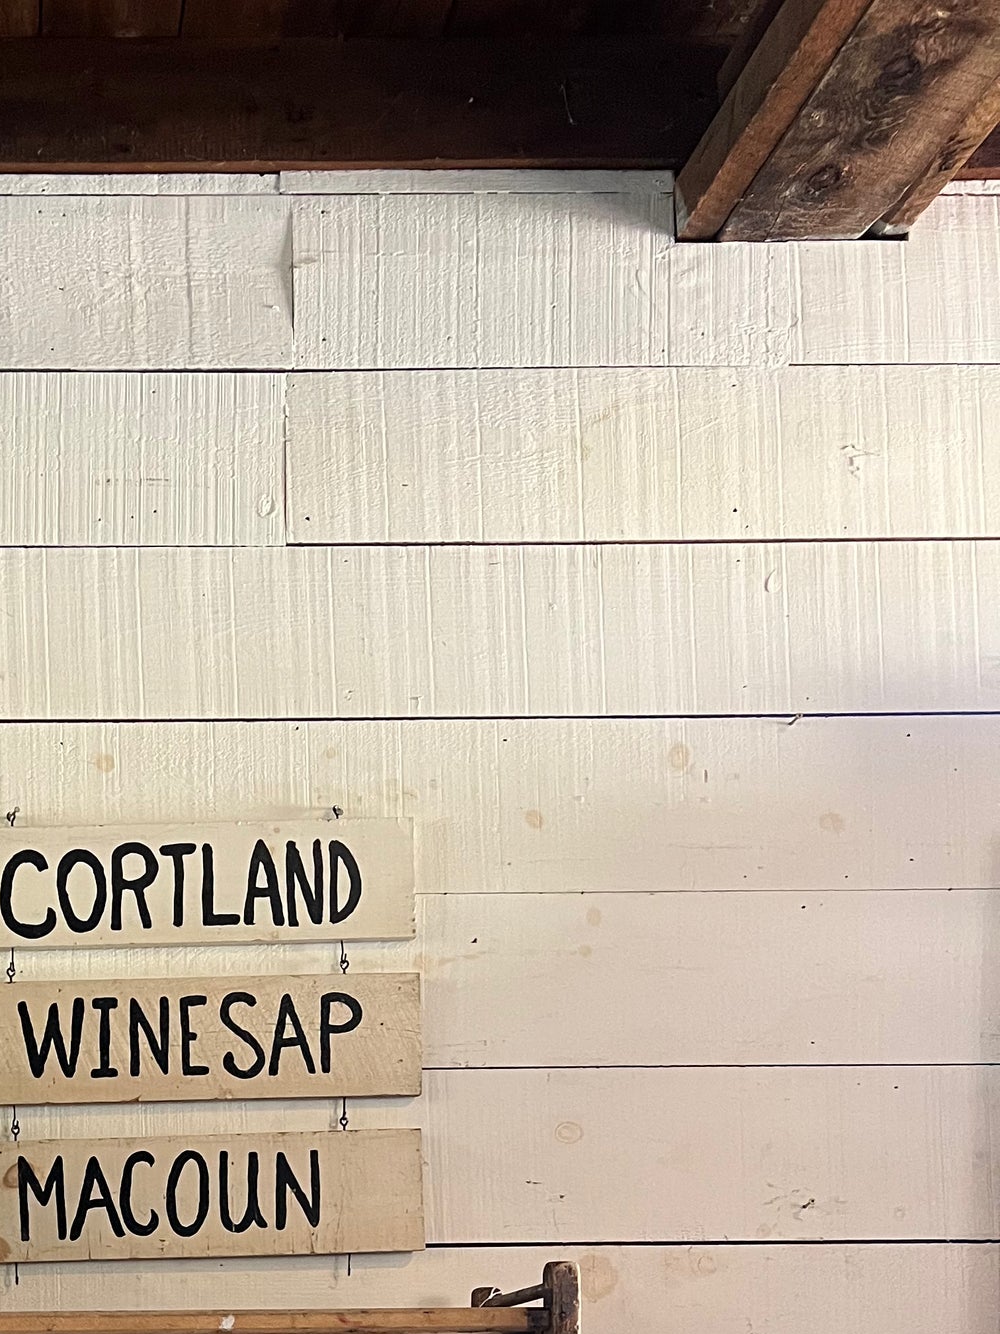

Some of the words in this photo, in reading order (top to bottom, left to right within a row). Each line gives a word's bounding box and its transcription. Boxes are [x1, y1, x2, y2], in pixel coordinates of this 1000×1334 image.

[0, 838, 362, 940] CORTLAND
[17, 991, 363, 1080] WINESAP
[17, 1149, 321, 1242] MACOUN
